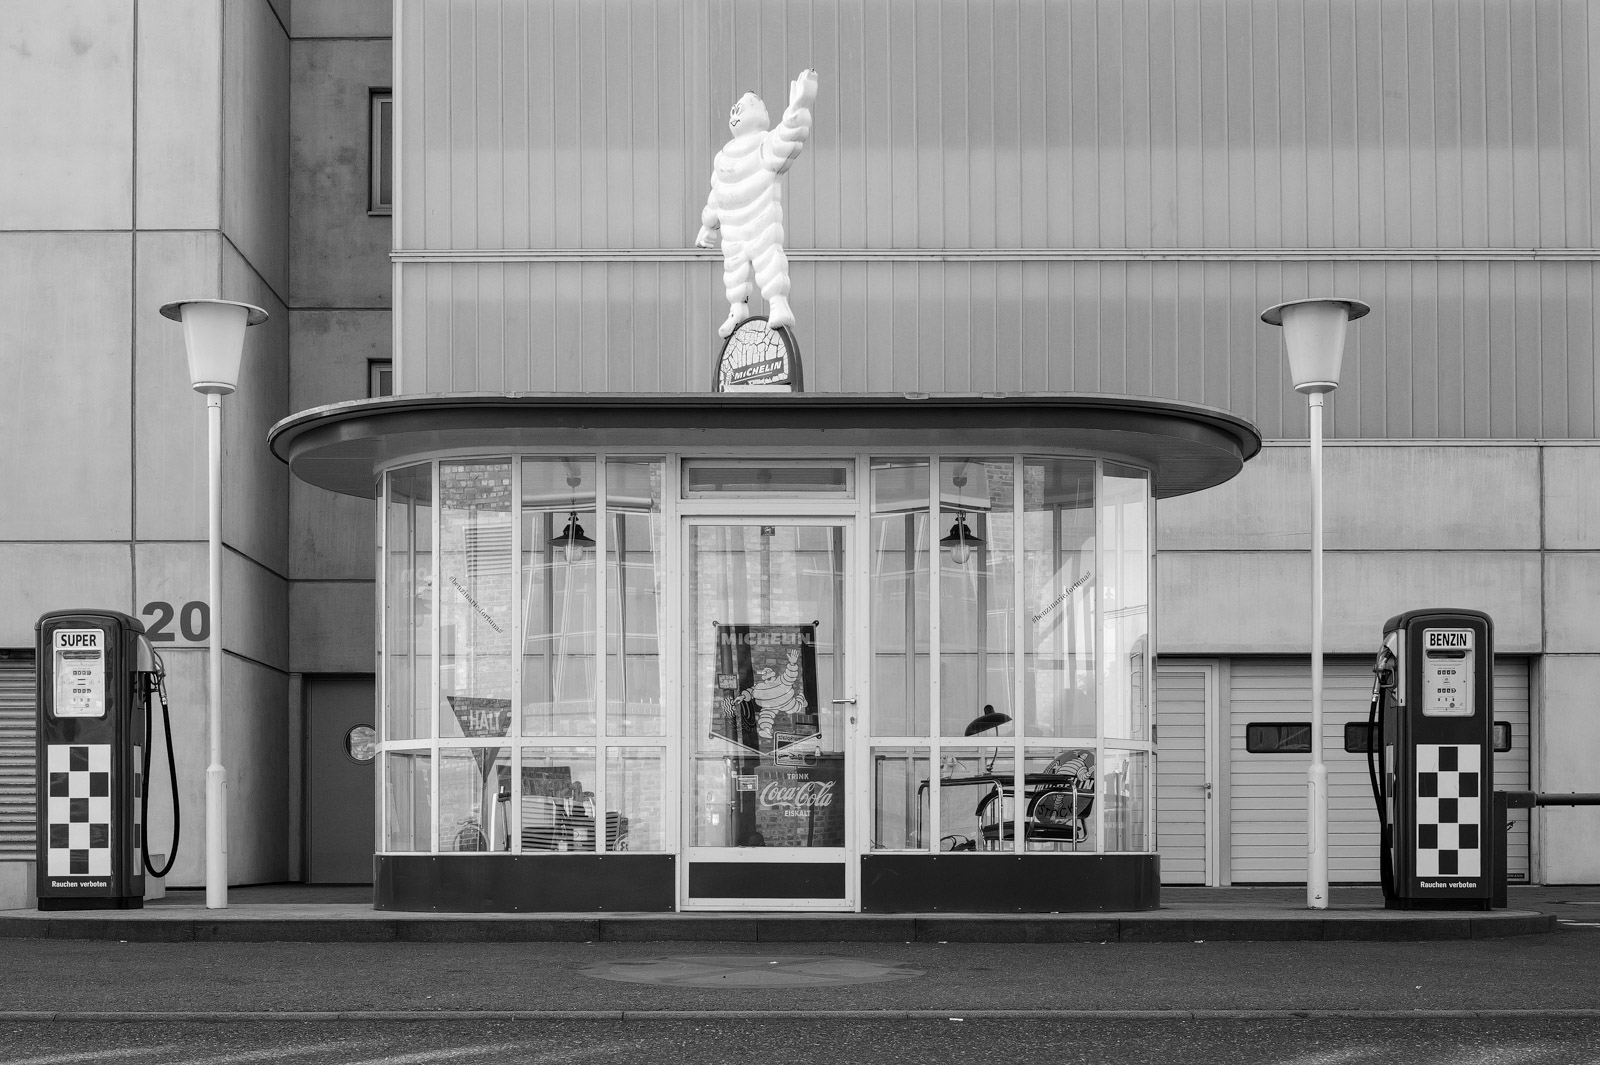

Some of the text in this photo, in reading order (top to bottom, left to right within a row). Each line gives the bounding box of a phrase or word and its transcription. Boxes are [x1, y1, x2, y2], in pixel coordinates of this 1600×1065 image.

[734, 361, 782, 380] MICHELIN
[142, 601, 210, 641] 20
[61, 634, 97, 647] SUPER
[721, 632, 811, 645] MICHELIN
[1430, 633, 1467, 647] BENZIN
[469, 709, 501, 731] HALT
[51, 880, 107, 888] Rauchen verboten
